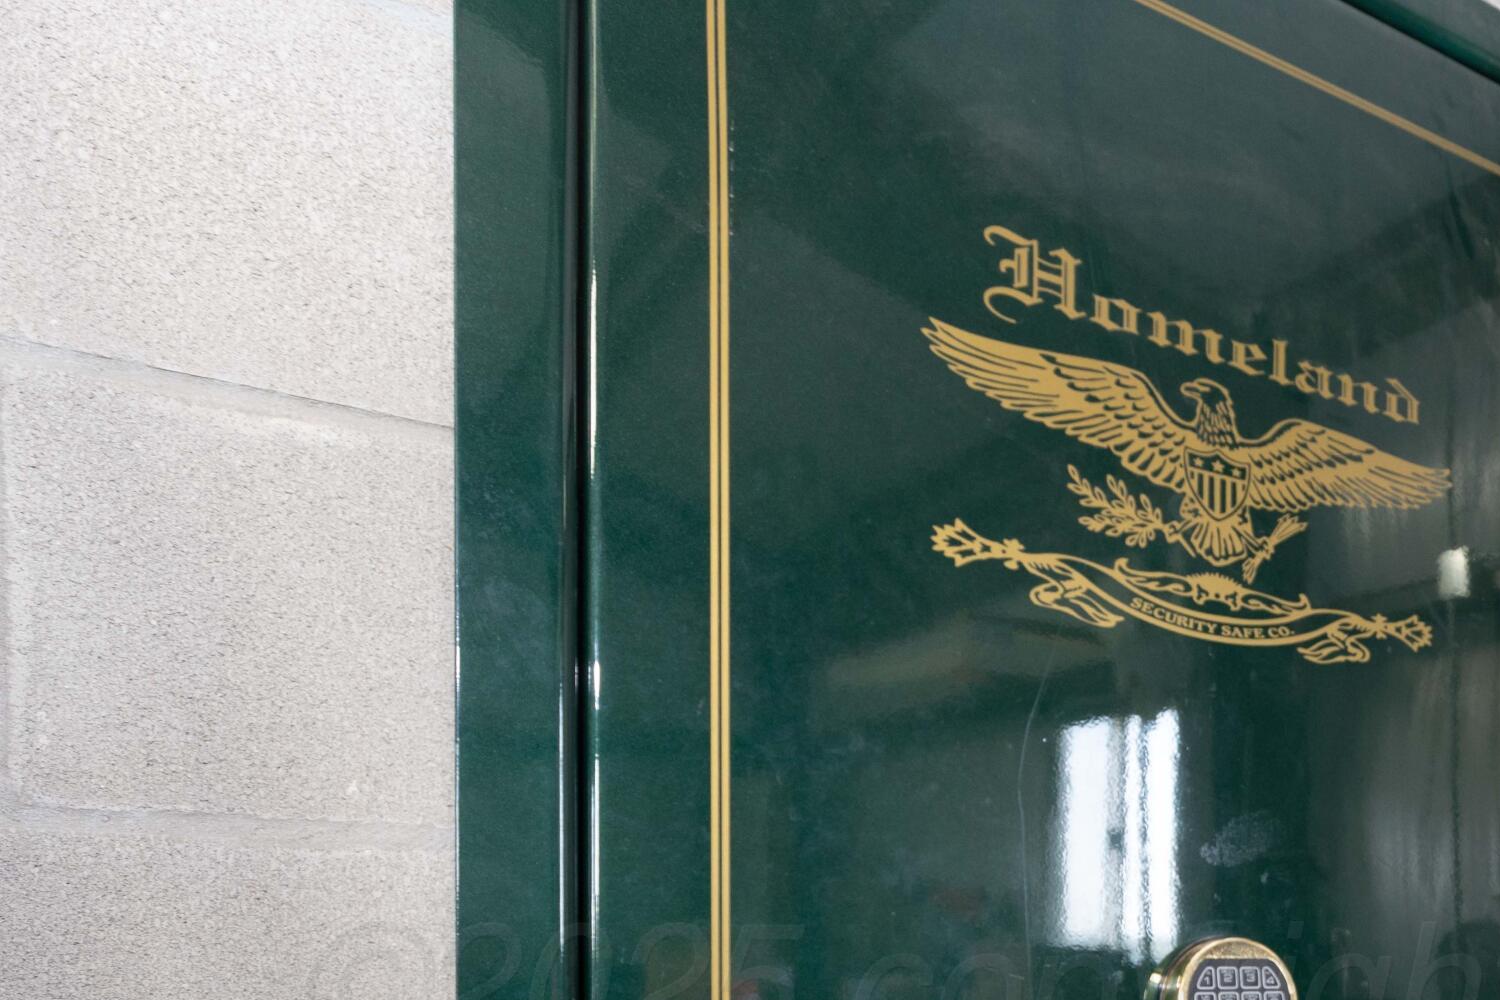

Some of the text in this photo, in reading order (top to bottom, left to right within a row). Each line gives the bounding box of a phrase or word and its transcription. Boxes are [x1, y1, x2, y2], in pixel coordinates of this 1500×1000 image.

[983, 225, 1420, 424] Homeland
[1130, 597, 1296, 639] SECURITY SAFE CO.
[1223, 974, 1233, 983] 2
[1246, 973, 1256, 982] 3
[1266, 976, 1275, 984] 4
